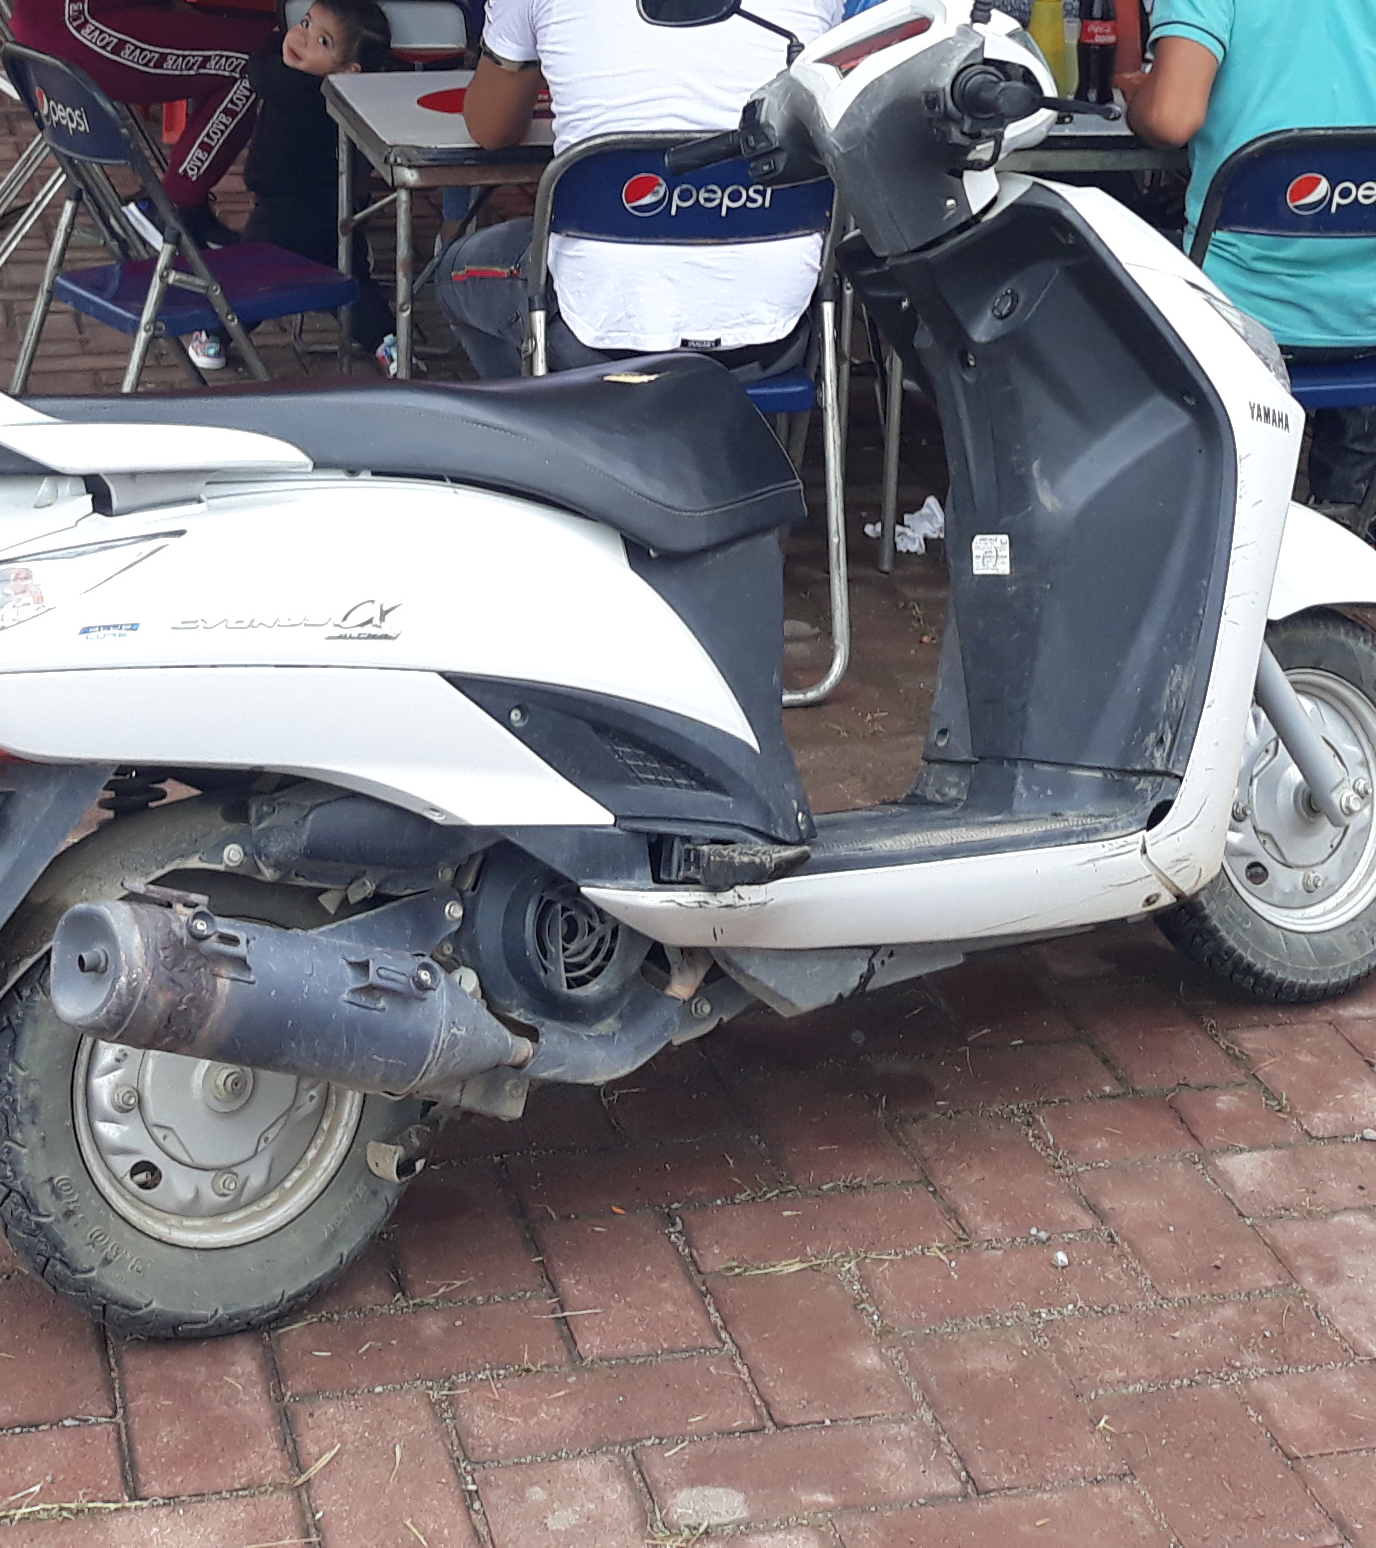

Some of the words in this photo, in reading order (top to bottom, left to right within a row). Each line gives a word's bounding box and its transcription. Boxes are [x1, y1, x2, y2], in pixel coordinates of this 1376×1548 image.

[81, 24, 119, 52] LOVE
[121, 43, 160, 68] LOVE
[164, 54, 203, 72] LOVE
[207, 54, 246, 75] LOVE
[48, 102, 91, 137] pepsi
[186, 148, 209, 179] OVE
[204, 113, 233, 148] LOVE
[671, 183, 772, 217] pepsi
[1248, 400, 1290, 433] YAMAHA
